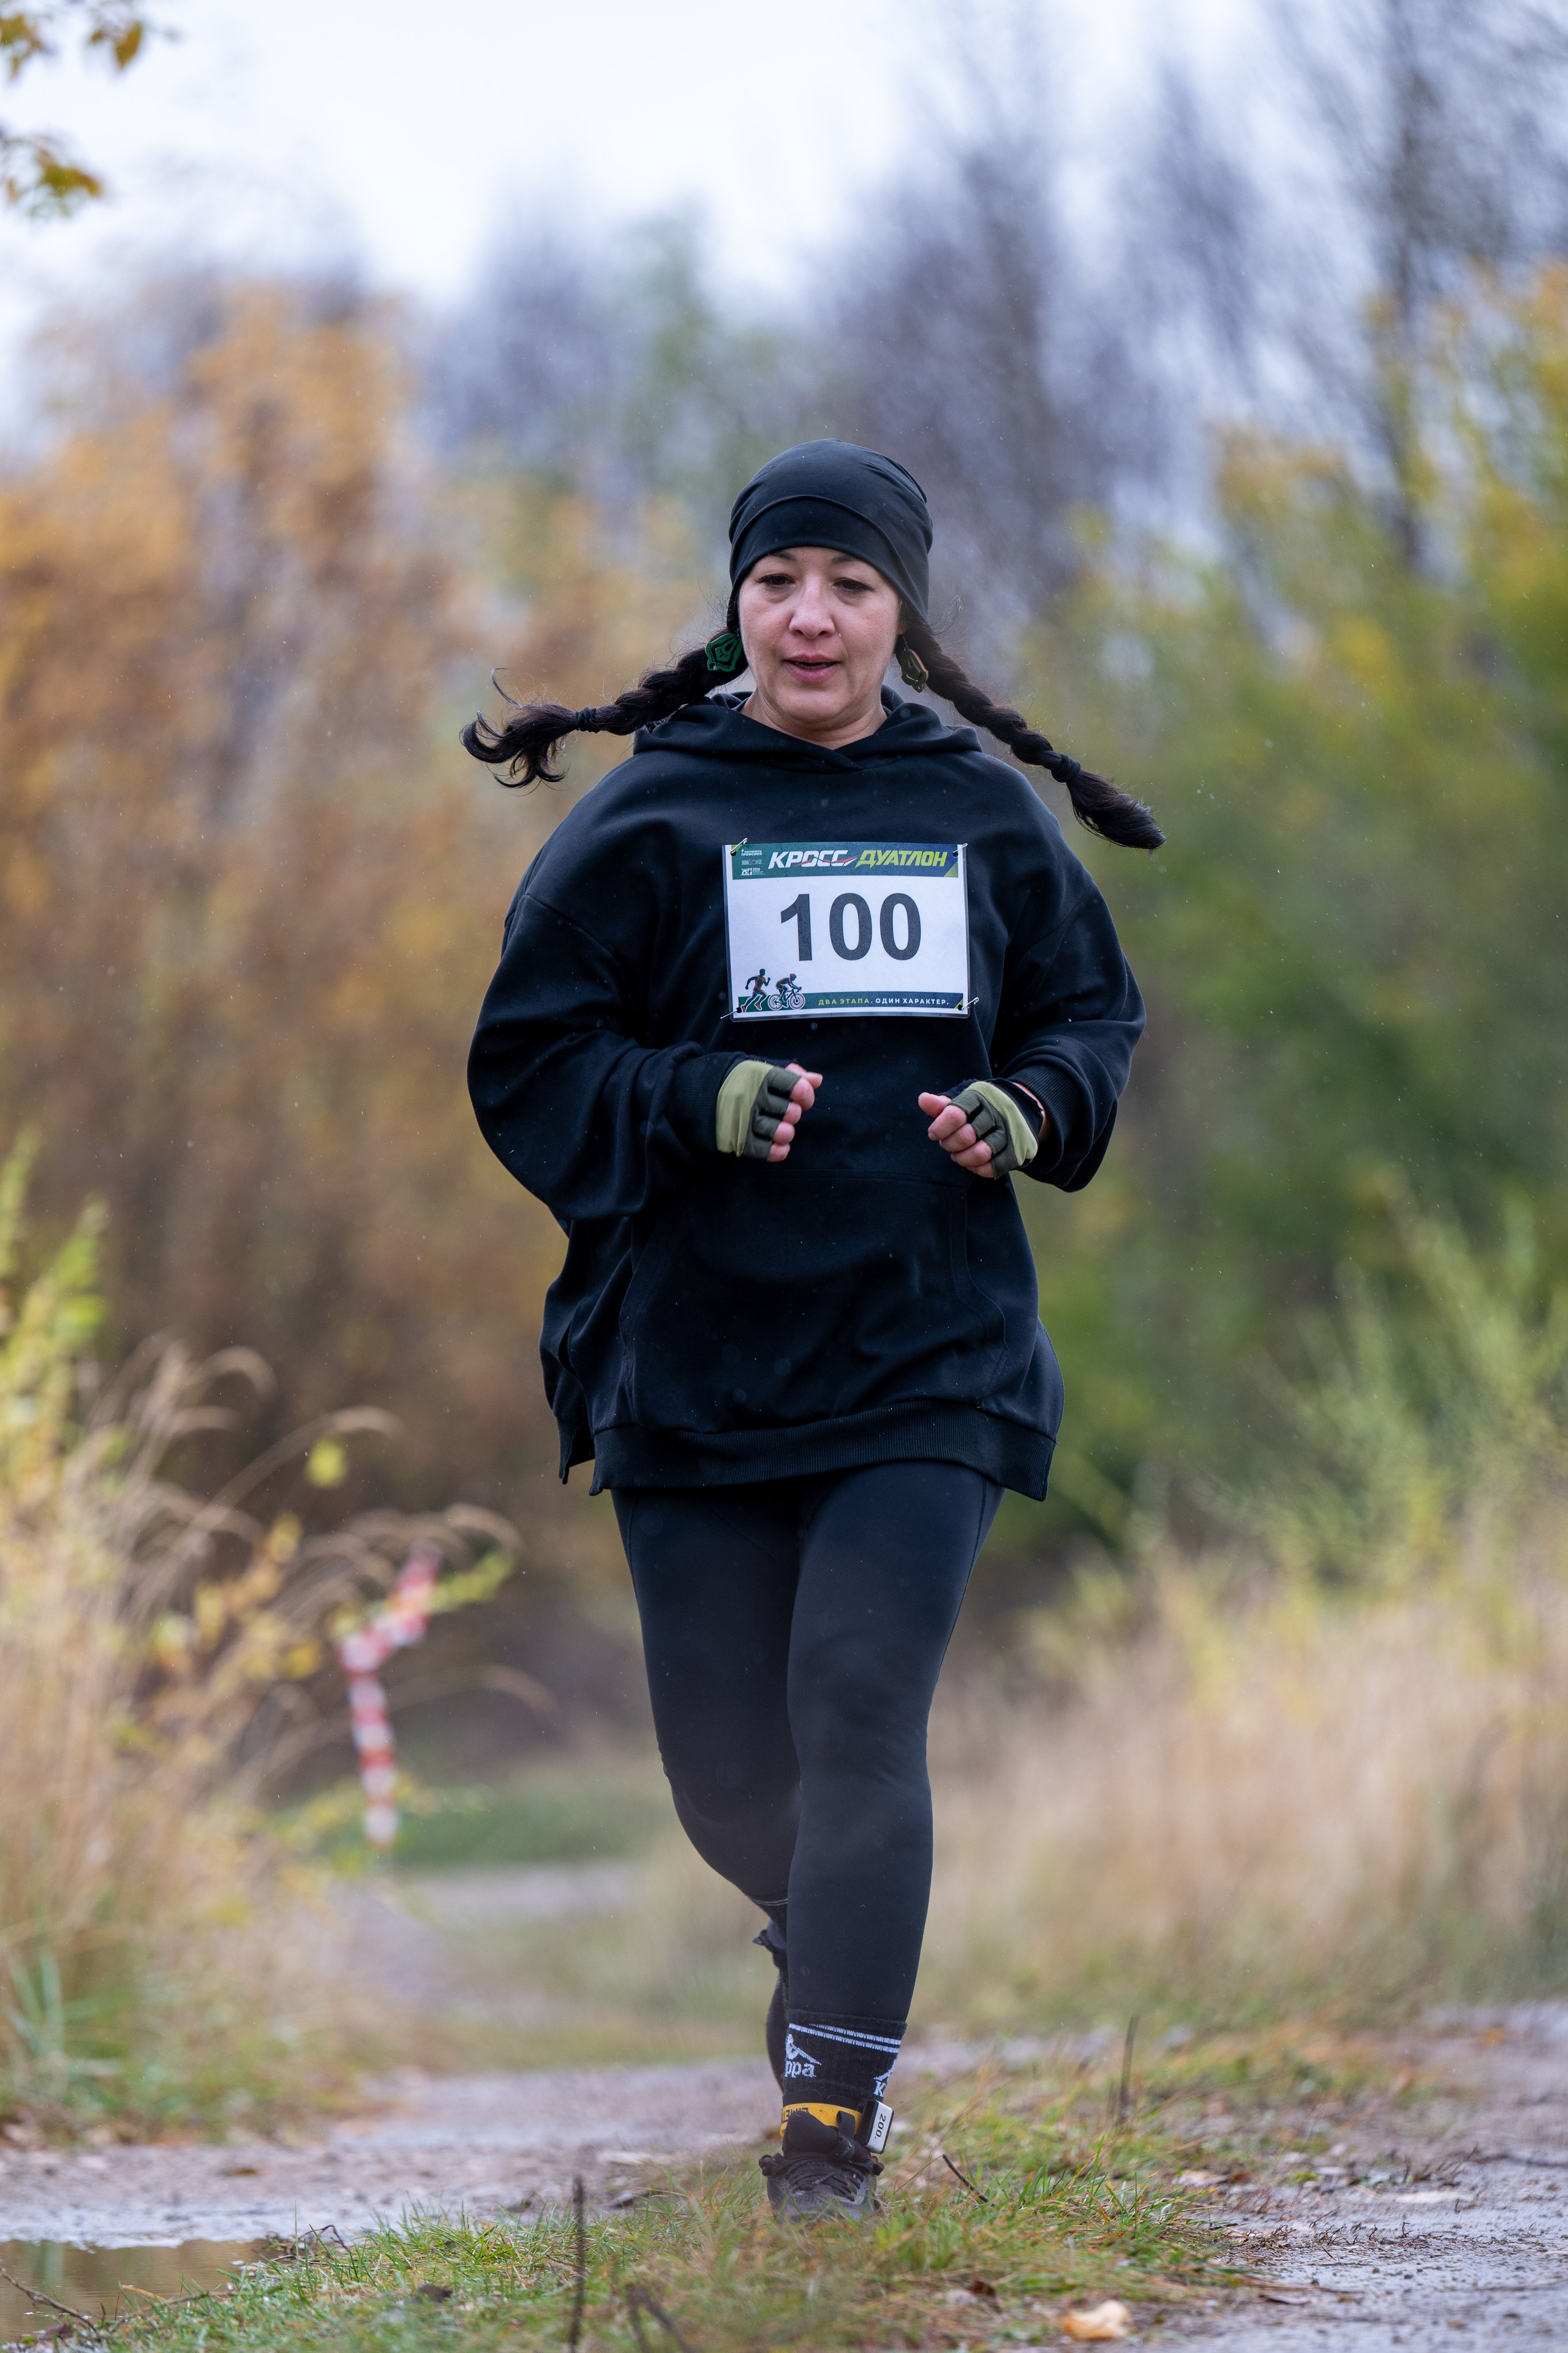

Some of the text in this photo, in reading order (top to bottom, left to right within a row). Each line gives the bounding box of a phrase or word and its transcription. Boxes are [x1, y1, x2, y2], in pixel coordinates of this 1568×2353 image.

[768, 850, 948, 869] КРОСС ДУАТЛОН
[780, 893, 921, 961] 100
